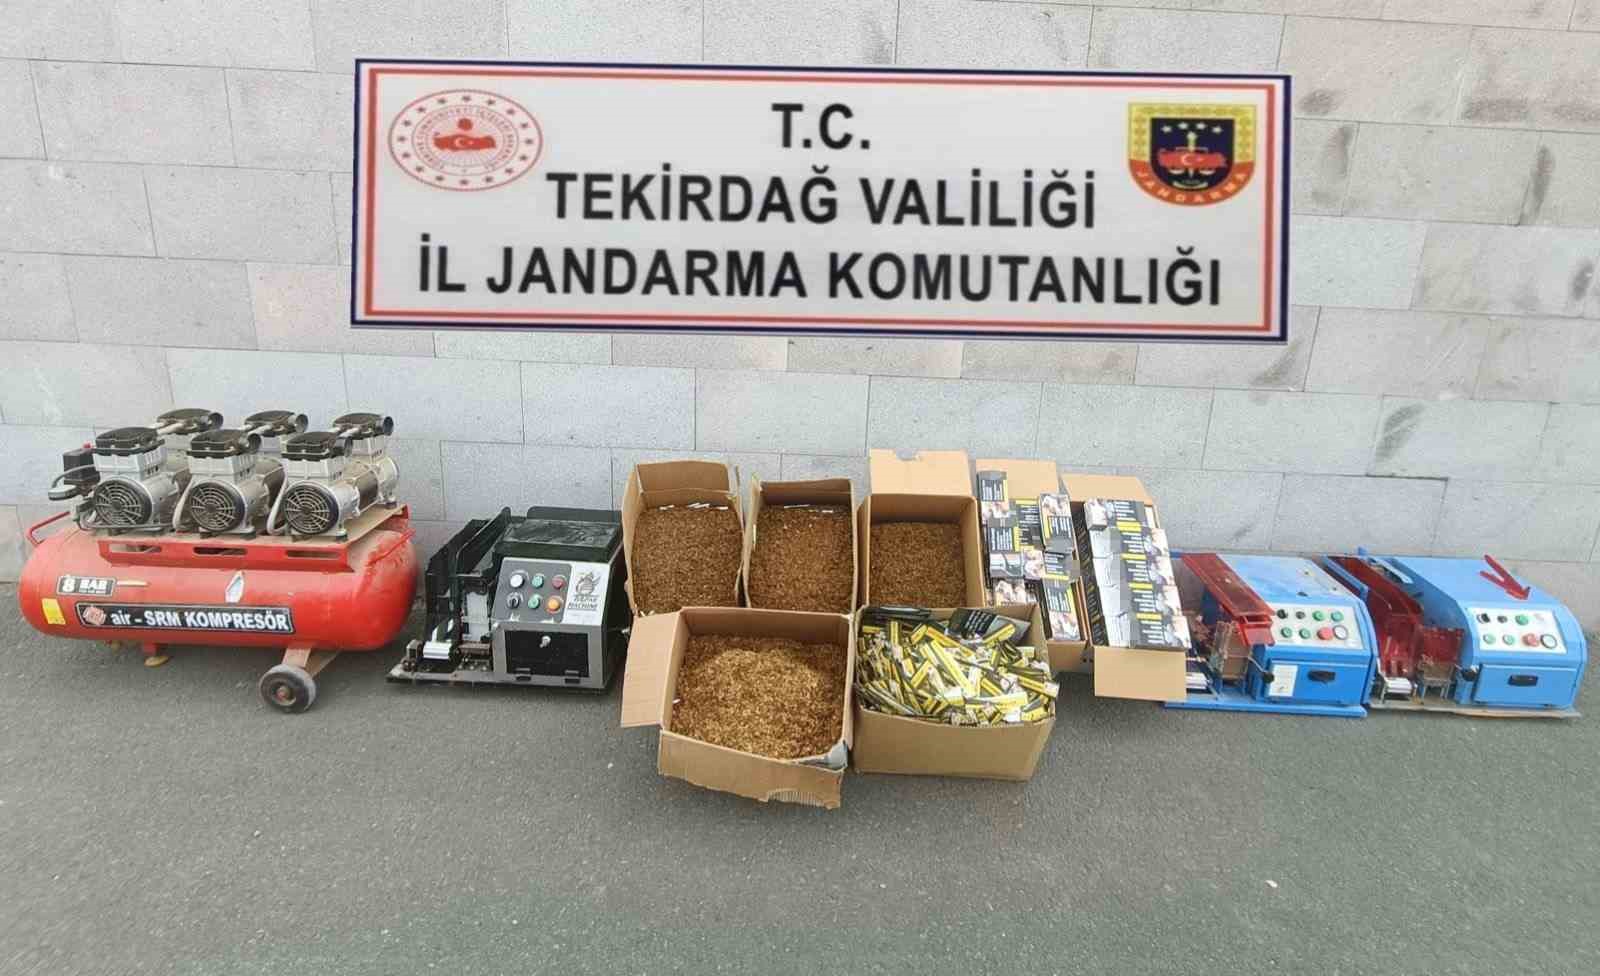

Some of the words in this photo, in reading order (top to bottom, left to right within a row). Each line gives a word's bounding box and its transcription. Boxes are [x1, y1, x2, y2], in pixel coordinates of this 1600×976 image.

[771, 103, 870, 151] T.C.
[546, 162, 838, 226] TEKİRDAĞ
[859, 168, 1095, 229] VALİLİĞİ
[419, 233, 466, 293] İL
[486, 246, 808, 299] JANDARMA
[828, 246, 1220, 306] KOMUTANLIĞI
[61, 577, 76, 593] 8
[110, 609, 131, 626] air
[144, 610, 181, 627] SRM
[184, 610, 290, 630] KOMPRESÖR
